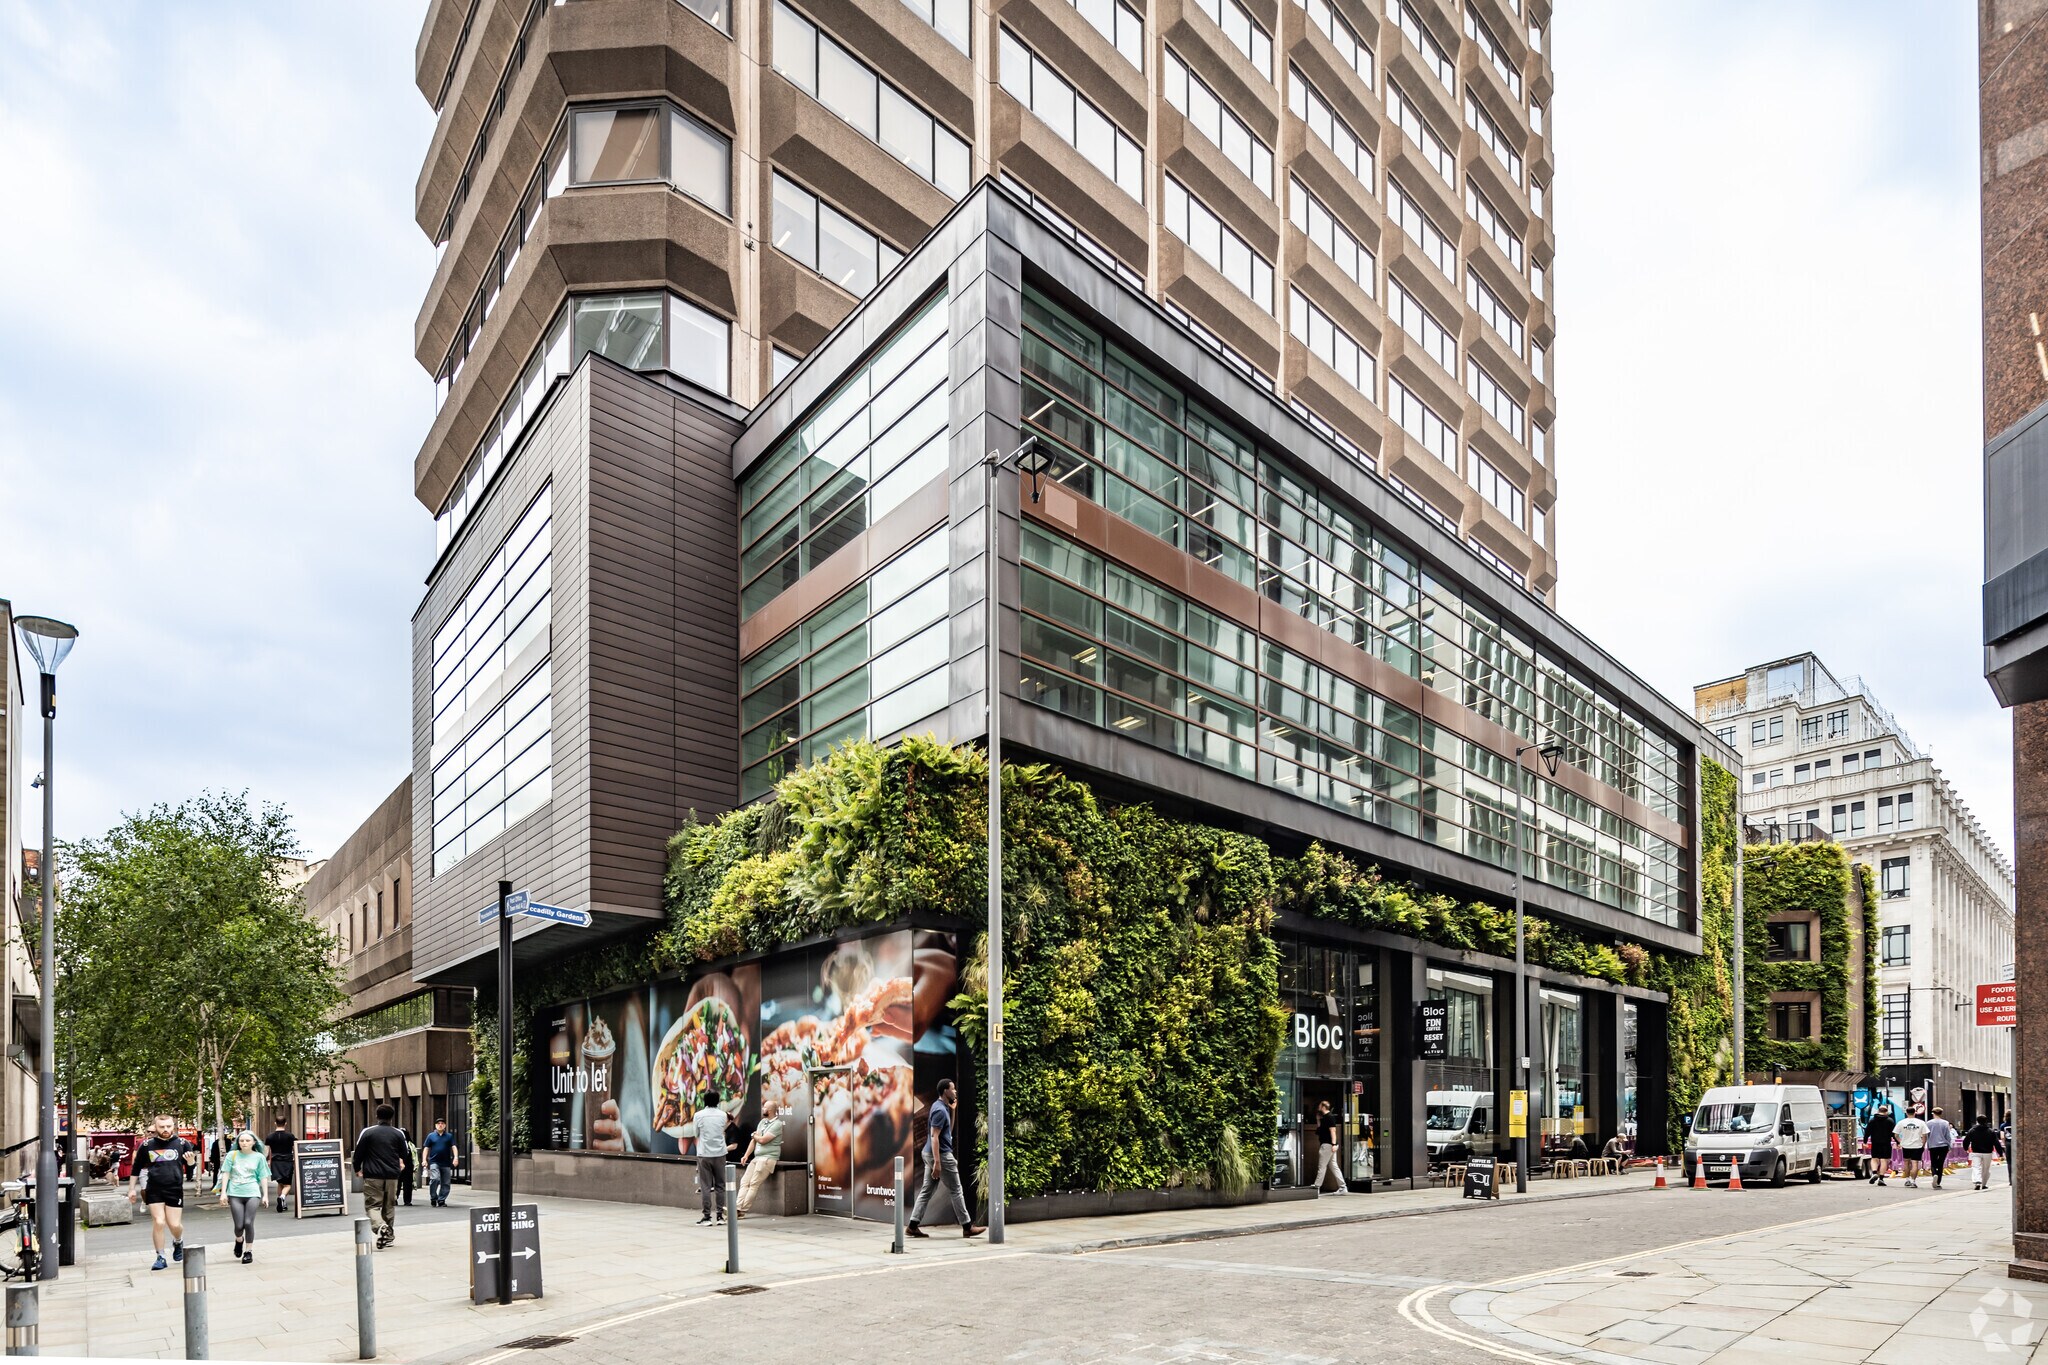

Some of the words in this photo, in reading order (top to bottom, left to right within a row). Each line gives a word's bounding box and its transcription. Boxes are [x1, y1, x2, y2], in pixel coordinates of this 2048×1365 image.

[529, 906, 555, 917] ccadilly
[556, 910, 584, 921] Gardens
[1983, 996, 2006, 1004] AHEAD
[1423, 1007, 1445, 1016] Bloc
[1426, 1018, 1442, 1027] FDN
[1295, 1013, 1343, 1050] Bloc
[552, 1063, 574, 1094] Unit
[576, 1066, 588, 1093] to
[591, 1062, 607, 1092] let
[779, 1106, 785, 1116] to
[785, 1105, 793, 1116] let
[866, 1184, 896, 1196] bruntwoo
[482, 1212, 516, 1222] COFE
[517, 1211, 527, 1220] IS
[475, 1220, 535, 1233] EVERHING
